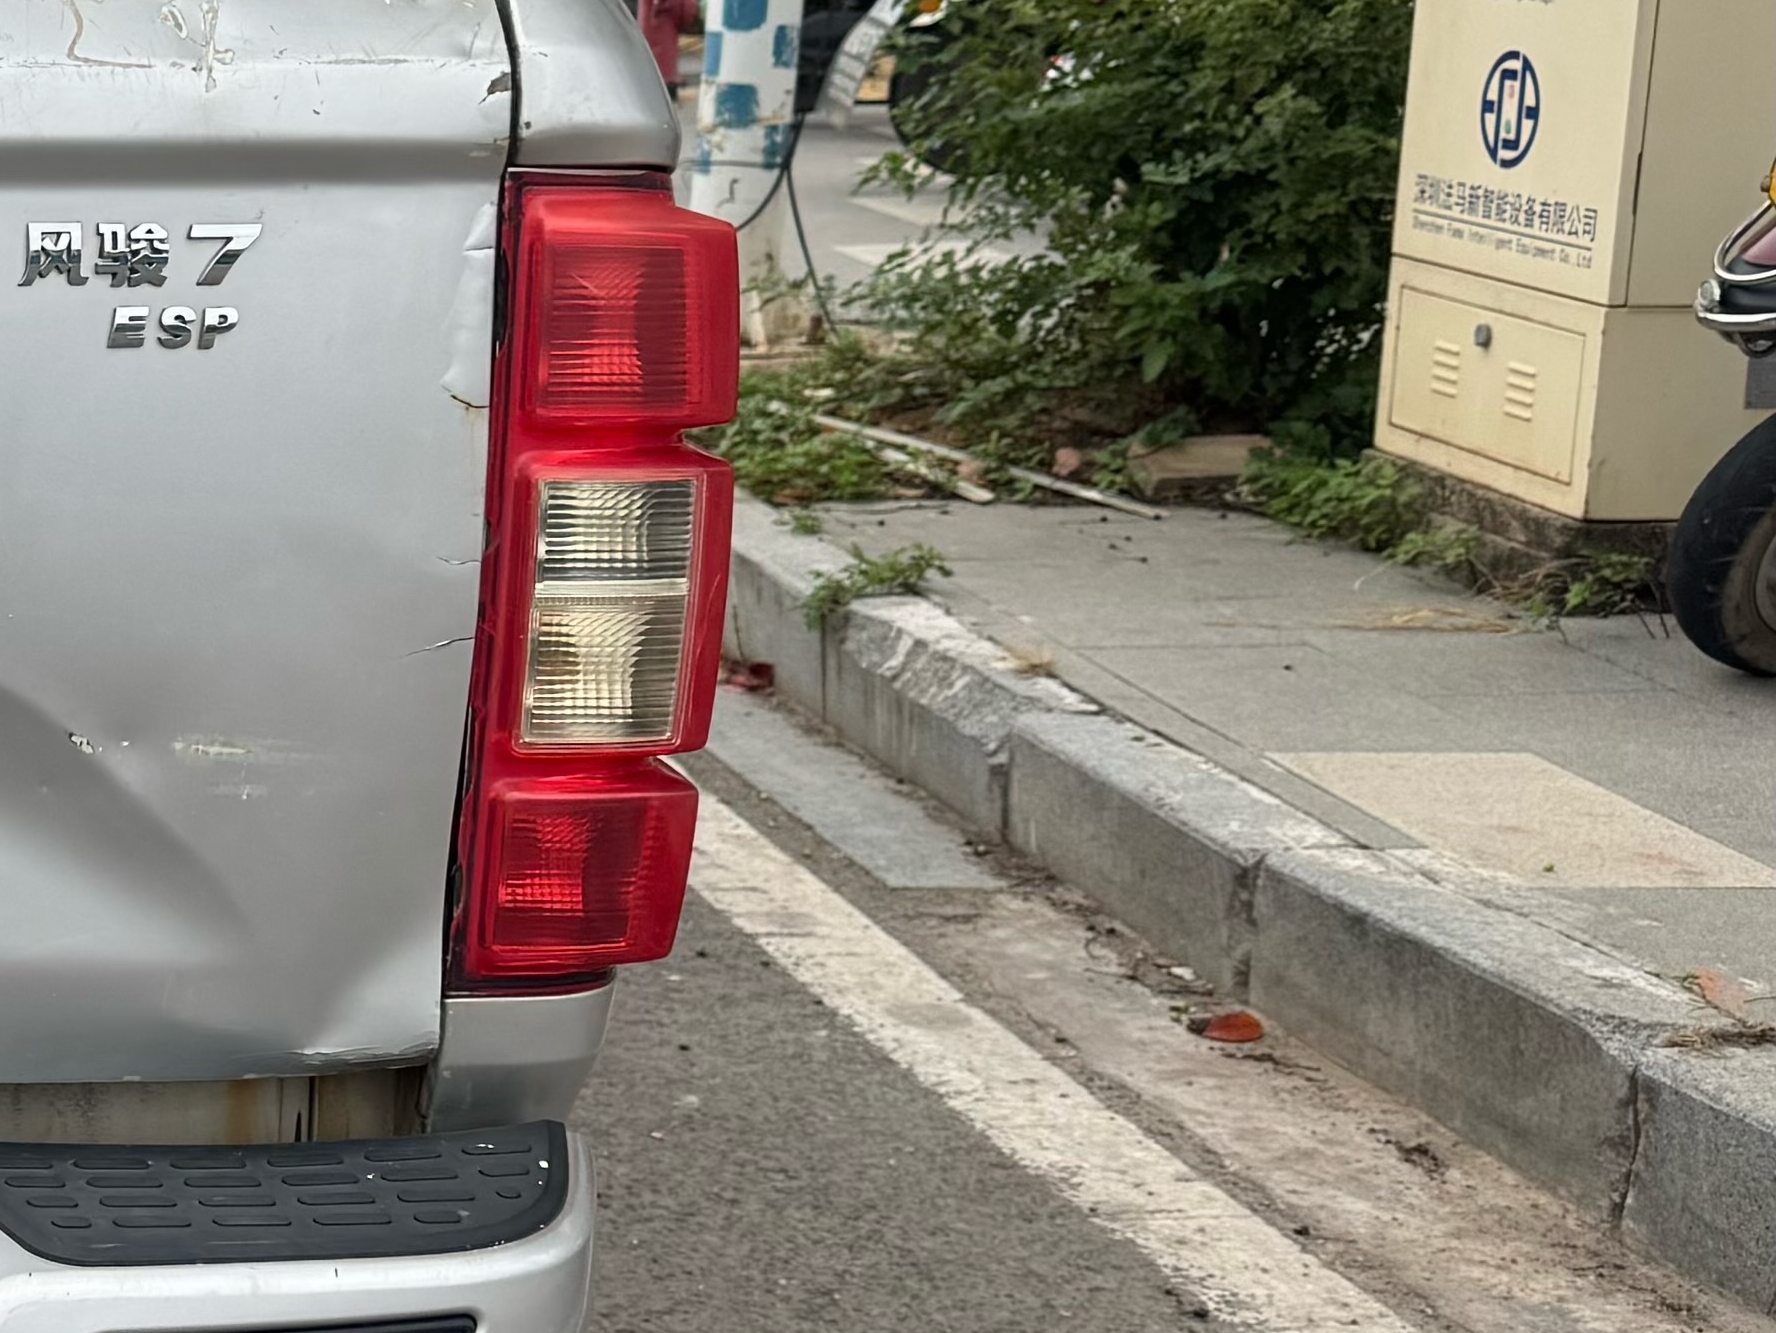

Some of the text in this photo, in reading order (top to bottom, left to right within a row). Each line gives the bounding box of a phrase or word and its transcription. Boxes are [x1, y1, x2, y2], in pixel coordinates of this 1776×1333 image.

[1413, 172, 1598, 243] 深圳法马新智能设备有限公司
[106, 305, 240, 350] ESP
